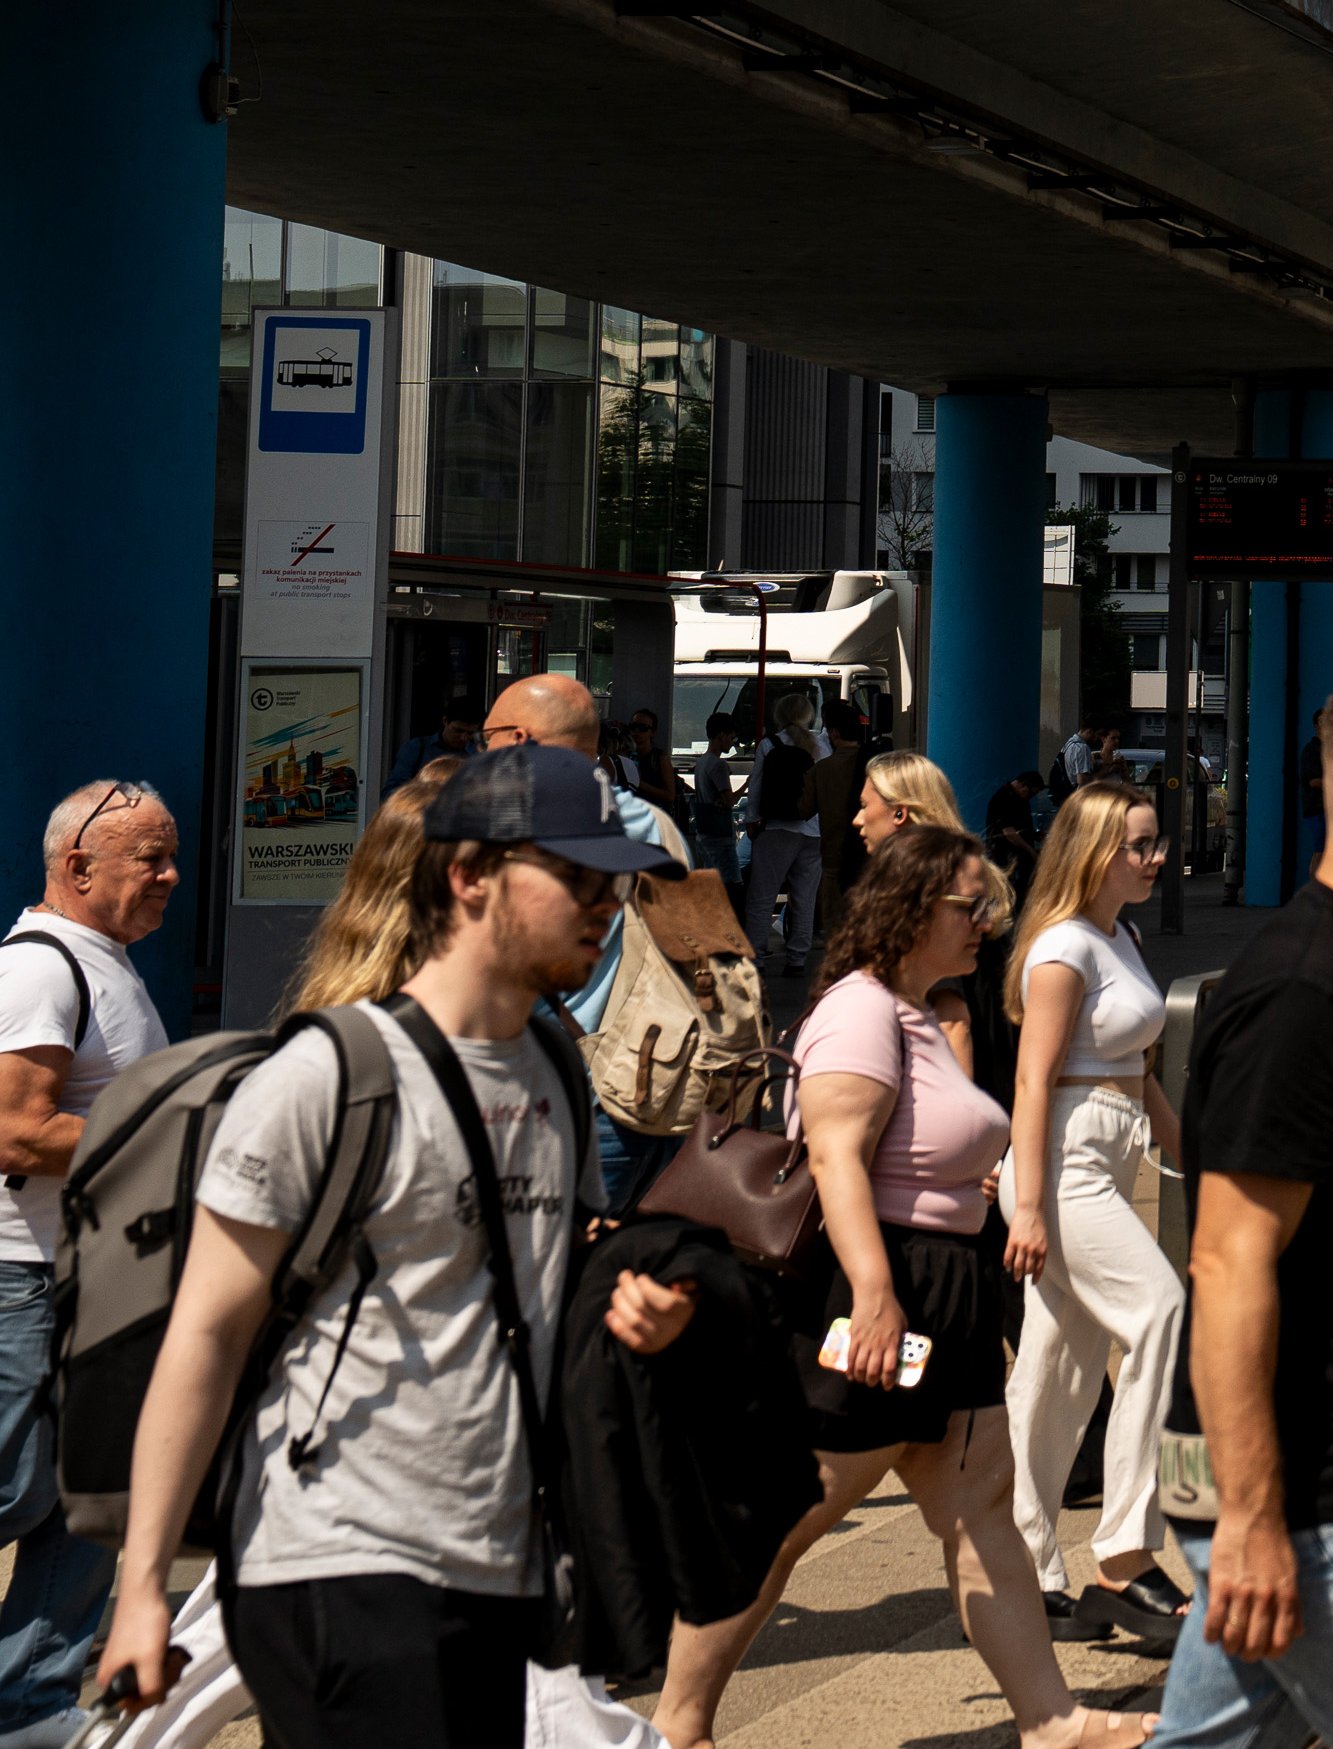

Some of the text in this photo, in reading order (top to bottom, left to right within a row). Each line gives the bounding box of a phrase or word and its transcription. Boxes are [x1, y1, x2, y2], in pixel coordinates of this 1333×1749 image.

[1209, 474, 1278, 485] Dw. Centralny 09
[318, 569, 362, 577] przystankach
[276, 576, 347, 585] komunikacji miejskiej
[248, 843, 354, 859] WARSZAWSKI
[248, 860, 302, 869] TRANSPORT
[251, 873, 280, 881] ZAWSZE
[290, 872, 315, 880] TWOIM
